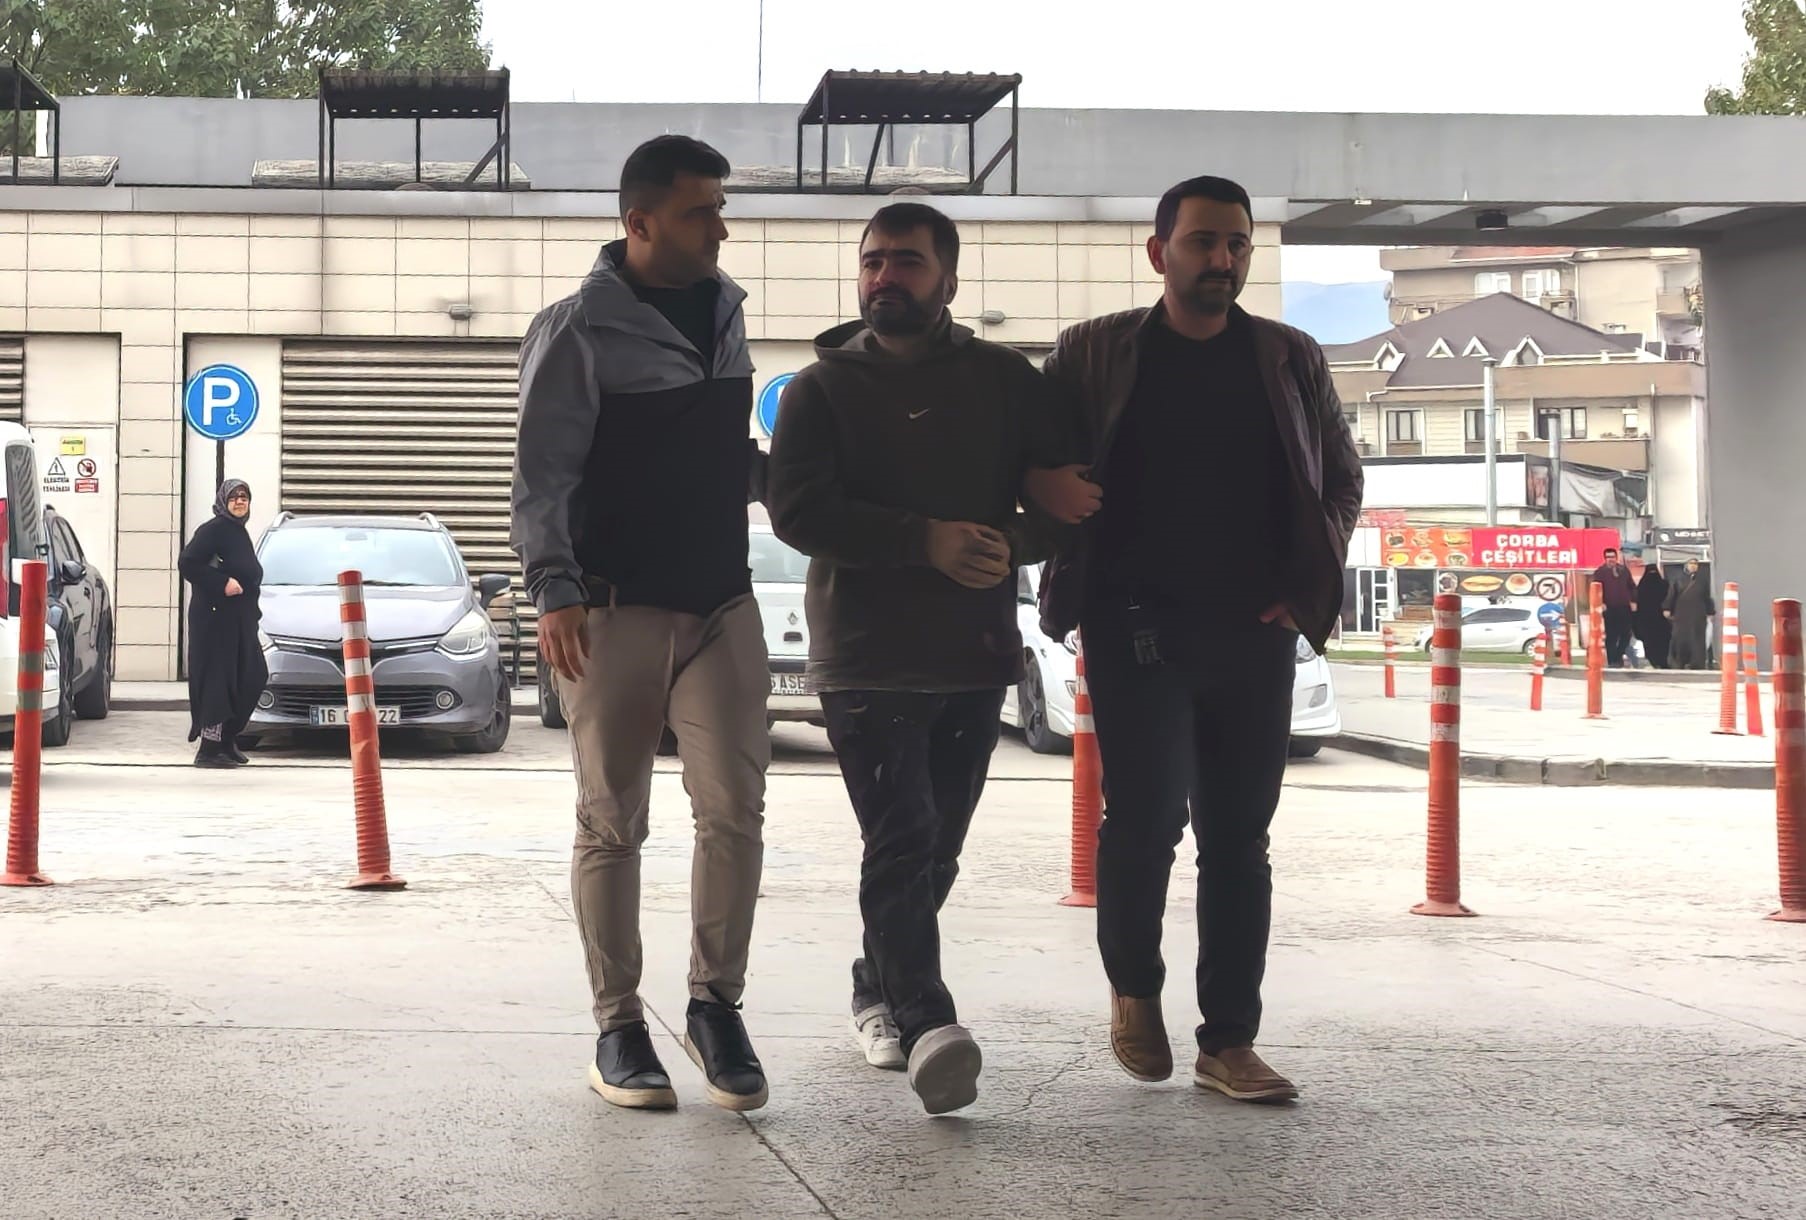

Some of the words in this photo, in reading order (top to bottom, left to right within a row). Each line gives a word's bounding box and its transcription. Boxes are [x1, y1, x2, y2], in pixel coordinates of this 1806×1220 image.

[203, 376, 240, 426] P
[1496, 533, 1560, 552] ÇORBA
[321, 708, 337, 723] 16
[379, 709, 398, 724] 22
